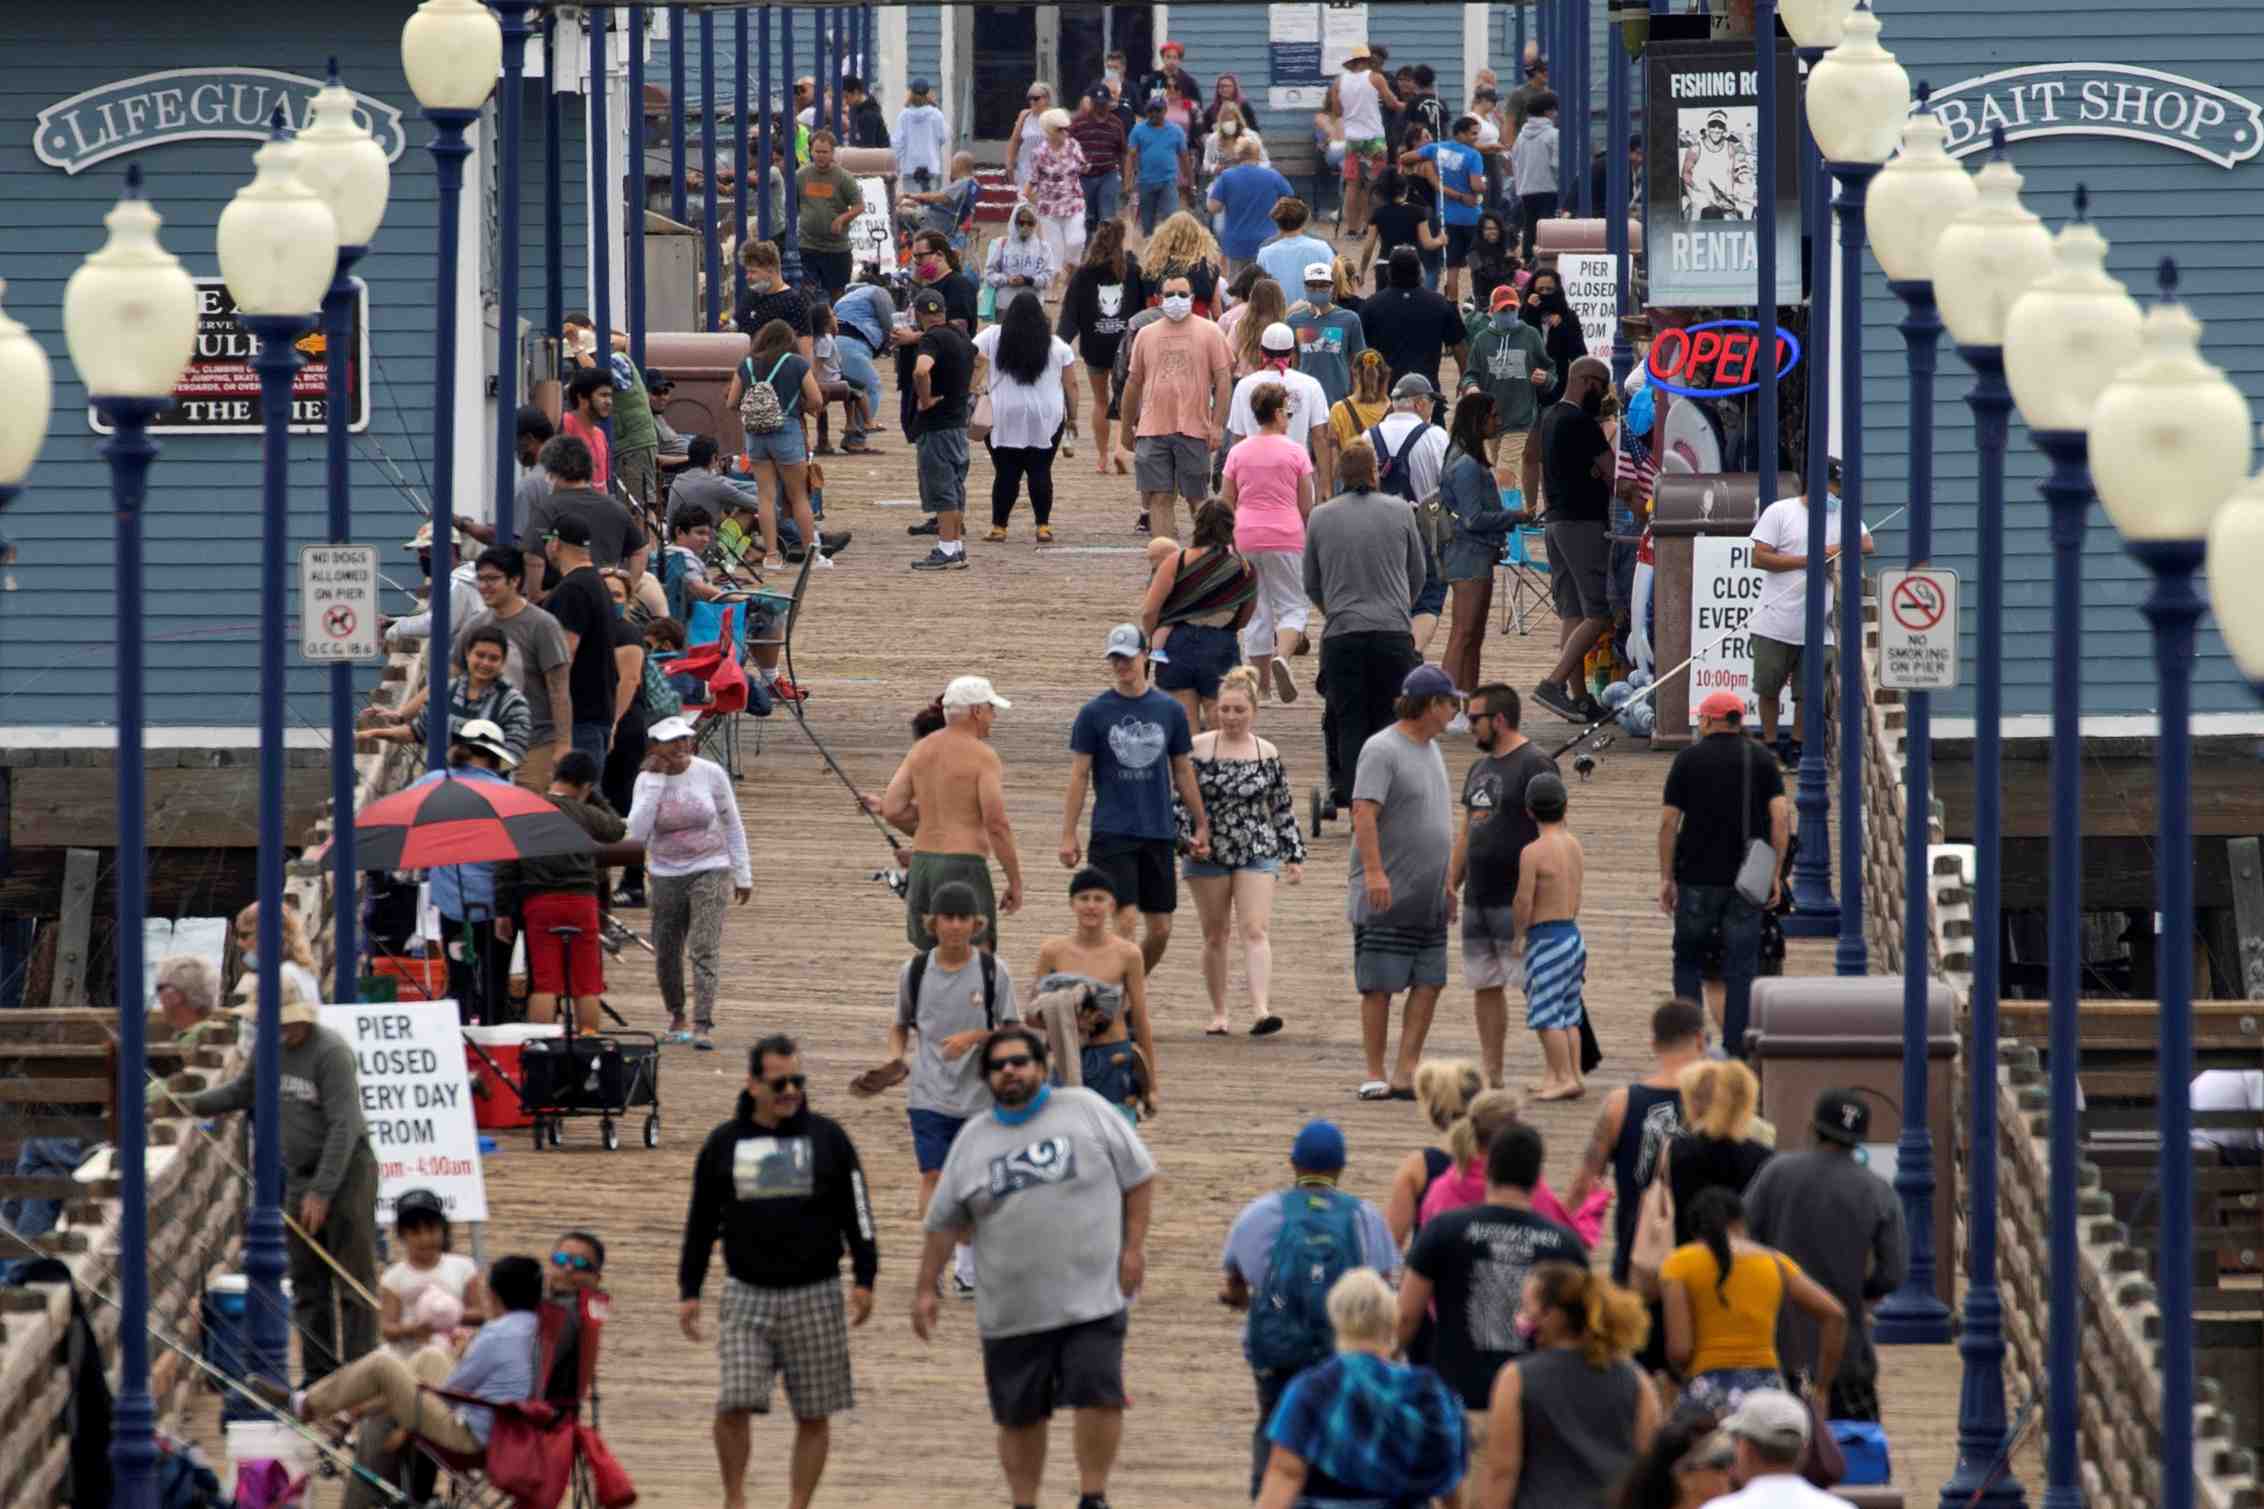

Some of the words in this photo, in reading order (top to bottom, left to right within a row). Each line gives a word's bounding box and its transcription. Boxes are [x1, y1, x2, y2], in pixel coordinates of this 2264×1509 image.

[1670, 71, 1736, 98] FISHING
[1932, 81, 2065, 147] BAIT
[2080, 81, 2226, 140] SHOP
[1672, 231, 1760, 271] RENTA
[1580, 261, 1609, 277] PIER
[1569, 282, 1617, 297] CLOSED
[1600, 303, 1617, 317] DA
[182, 401, 251, 421] THE
[1713, 577, 1764, 599] CLOS
[1699, 607, 1754, 629] EVER
[1908, 635, 1927, 646] NO
[1888, 648, 1949, 660] SMOKING
[1890, 662, 1909, 673] ON
[1914, 662, 1945, 673] PIER
[1696, 670, 1748, 690] 10:00pm
[357, 1015, 413, 1040] PIER
[358, 1050, 437, 1075] LOSED
[360, 1085, 408, 1110] ERY
[414, 1083, 460, 1108] DAY
